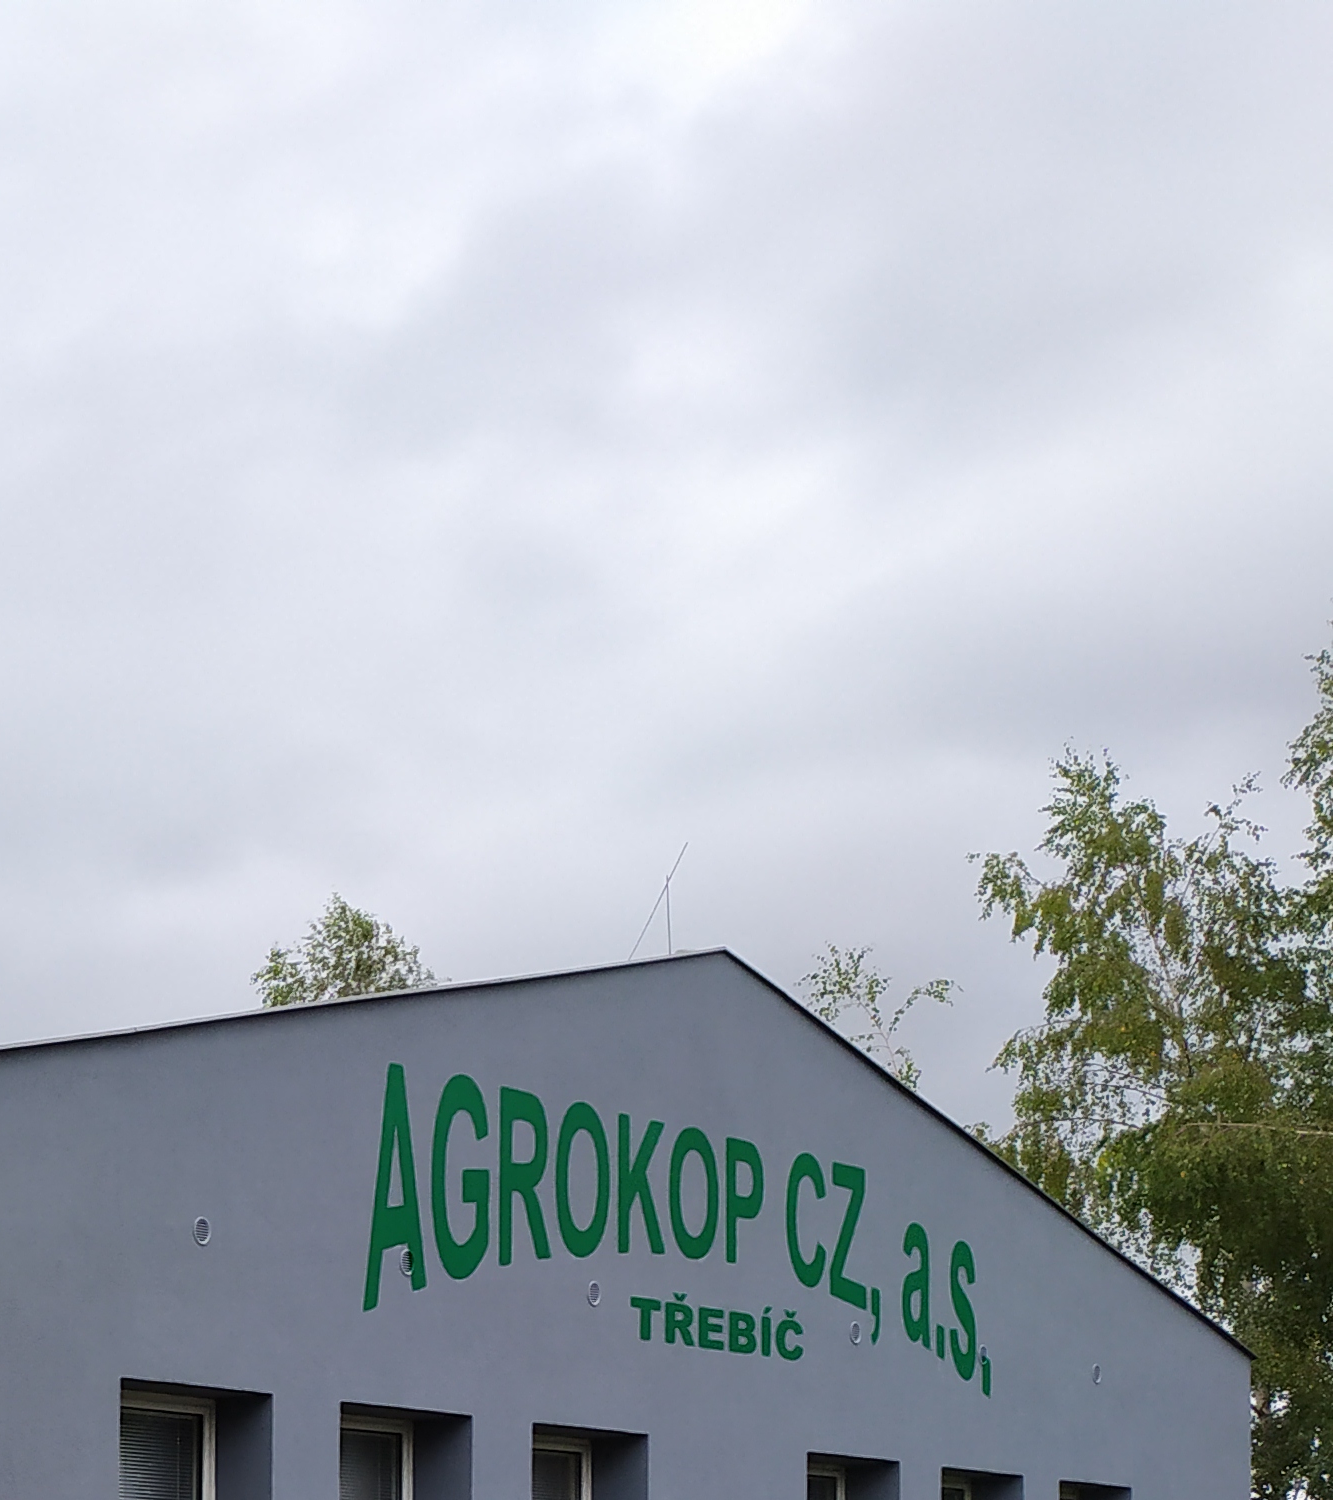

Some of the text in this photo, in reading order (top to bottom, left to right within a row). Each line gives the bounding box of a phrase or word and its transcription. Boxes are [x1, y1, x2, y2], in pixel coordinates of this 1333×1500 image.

[363, 1062, 992, 1398] AGROKOP CZ, a.s.
[630, 1292, 804, 1361] TŘEBÍČ
